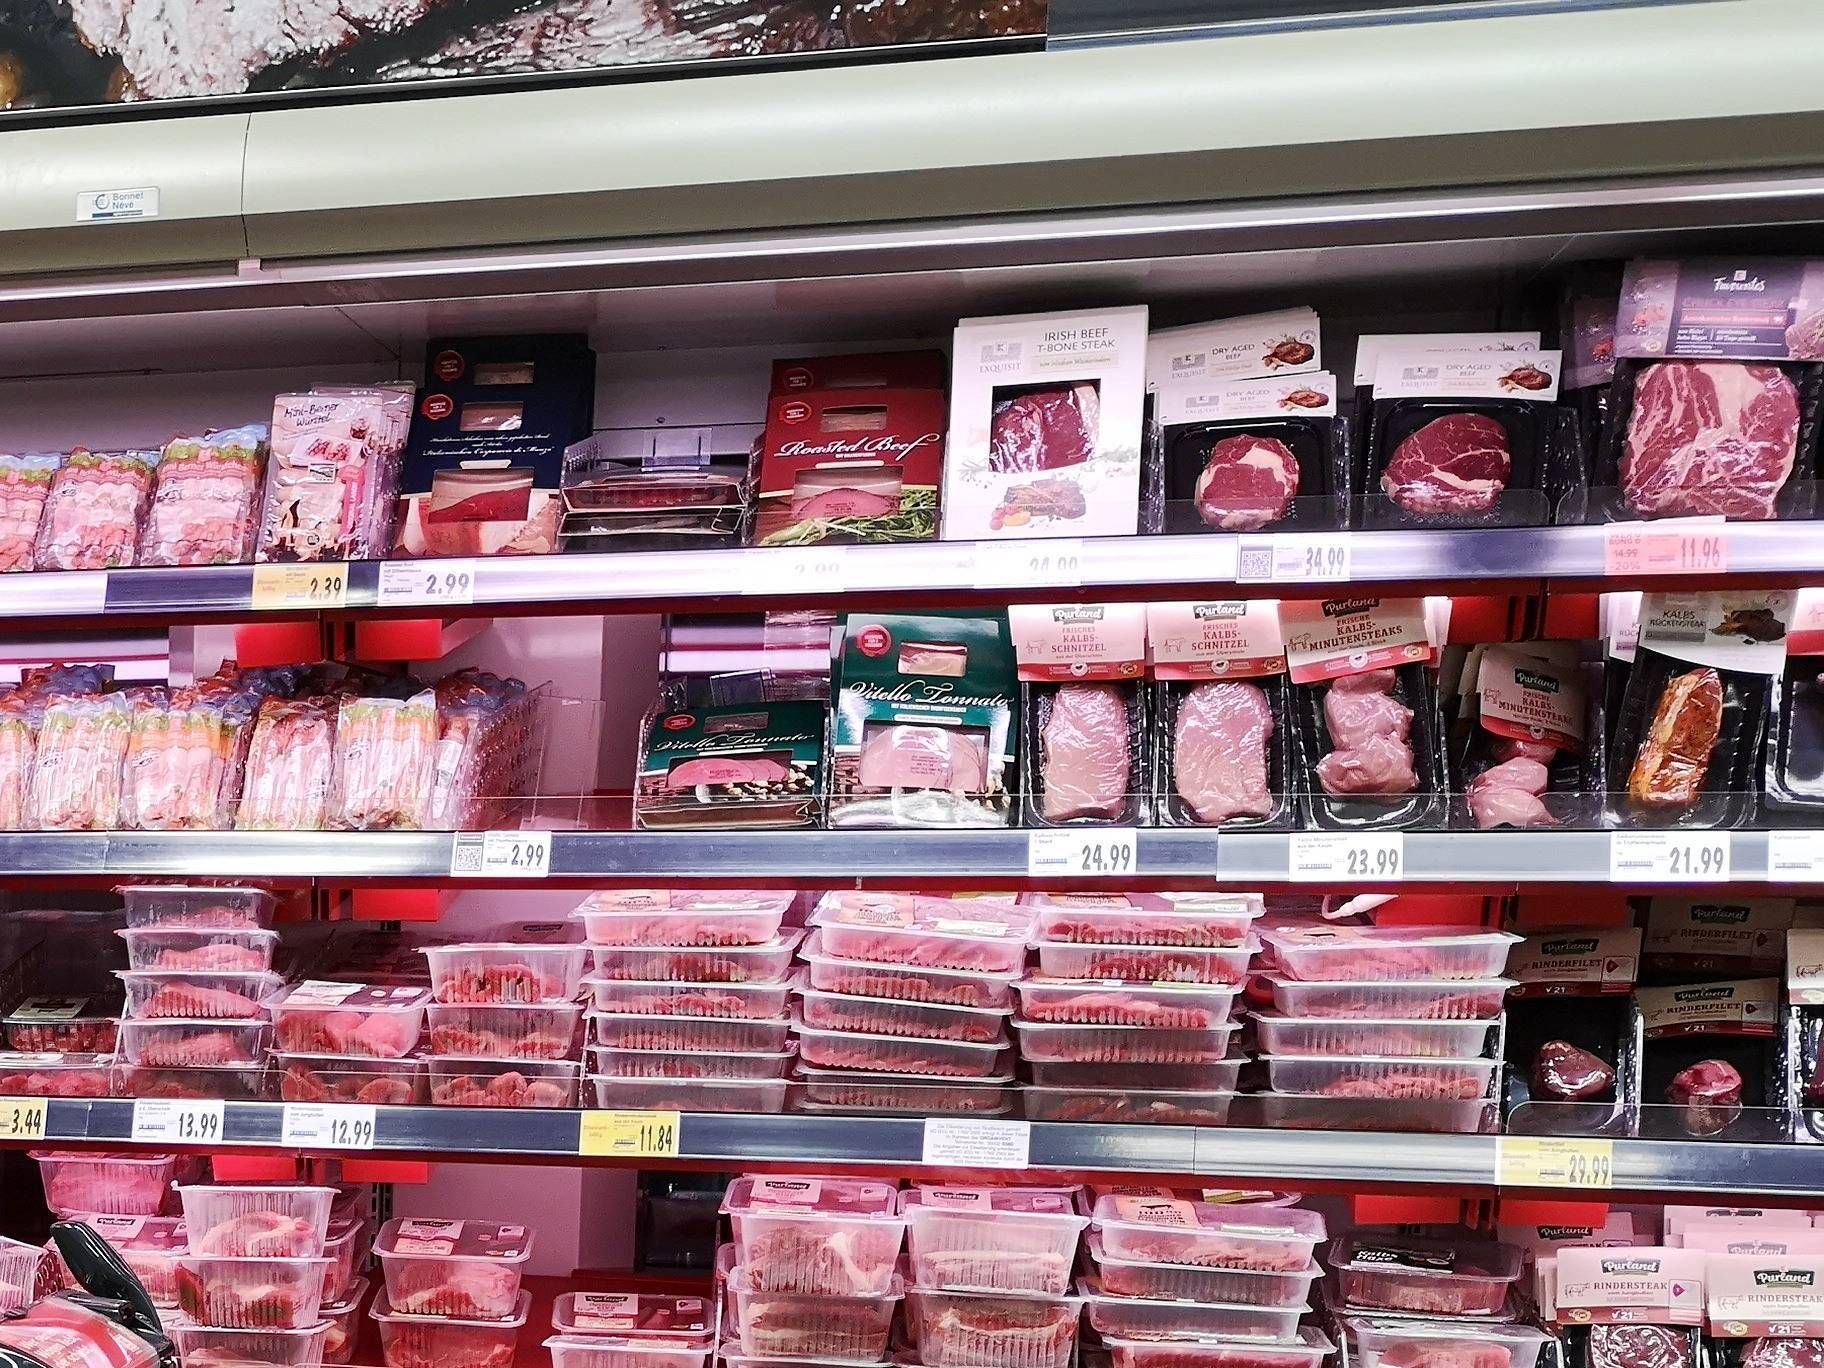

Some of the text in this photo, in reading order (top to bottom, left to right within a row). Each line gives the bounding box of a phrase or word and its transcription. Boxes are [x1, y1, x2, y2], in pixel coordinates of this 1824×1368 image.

[112, 191, 145, 202] Bonnet
[1044, 328, 1109, 342] IRISH BEEF
[1037, 339, 1116, 353] T-BONE STEAK
[1212, 343, 1256, 355] DRY AGED
[979, 362, 1022, 374] EXQUISIT
[774, 432, 941, 462] Roasted Beef
[1305, 546, 1346, 577] 34.99
[425, 572, 470, 595] 2.99
[1054, 607, 1103, 622] Purland
[1195, 603, 1247, 617] Purland
[1662, 609, 1696, 620] KALBS
[1203, 631, 1242, 641] KALBS-
[1336, 623, 1377, 636] KALBS-
[1062, 634, 1099, 644] KALBS-
[1191, 640, 1250, 651] SCHNITZEL
[1309, 625, 1403, 652] MINUTENSTEAKS
[1051, 643, 1107, 654] SCHNITZEL
[849, 679, 1016, 708] Vitello Tonnato
[654, 732, 816, 752] Vitello Tonnato
[510, 844, 544, 868] 2.99
[1081, 843, 1131, 871] 24.99
[1346, 848, 1400, 876] 23.99
[1669, 846, 1725, 875] 21.99
[1680, 928, 1753, 941] RINDERFILET
[1531, 957, 1603, 971] RINDERFILET
[1666, 1001, 1742, 1014] RINDERFILET
[11, 1108, 43, 1135] 3.44
[177, 1112, 219, 1139] 13.99
[330, 1118, 372, 1146] 12.99
[639, 1124, 674, 1152] 11.84
[1568, 1154, 1611, 1185] 29.99
[1601, 1257, 1661, 1275] Purland
[1593, 1280, 1669, 1292] RINDERSTEAK
[1755, 1270, 1815, 1287] Purland
[1747, 1293, 1824, 1305] RINDERSTEAK
